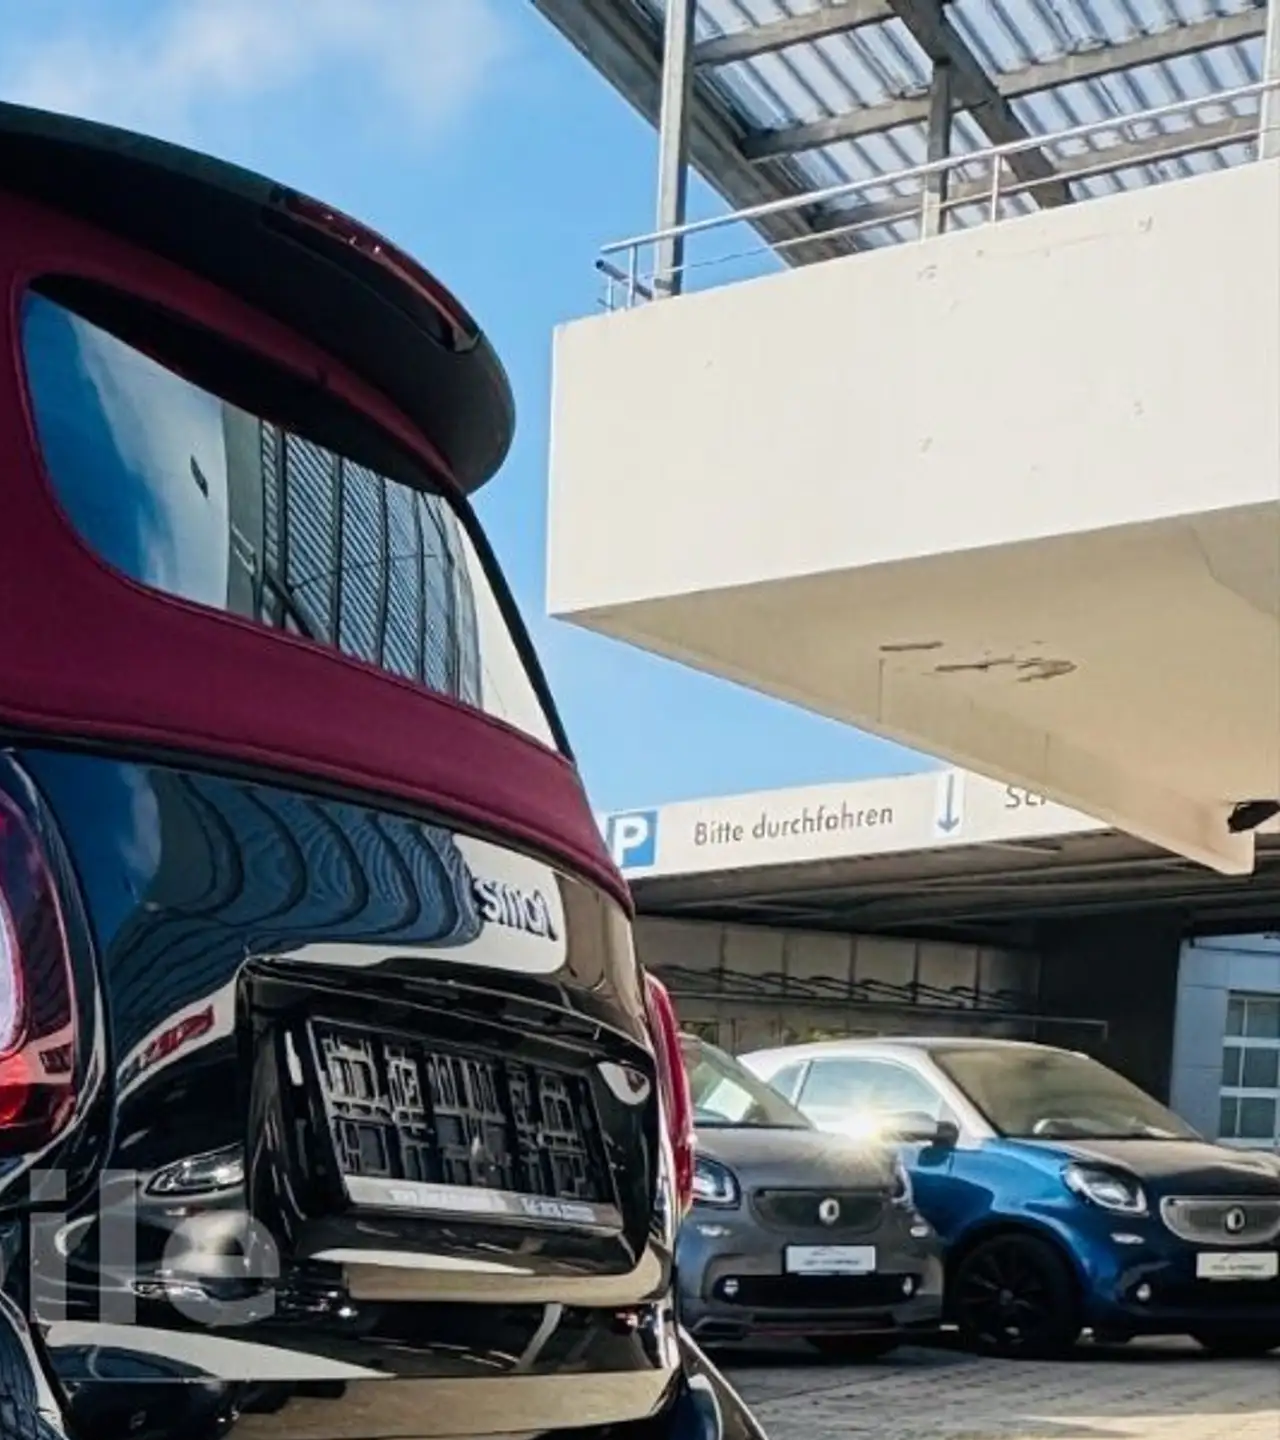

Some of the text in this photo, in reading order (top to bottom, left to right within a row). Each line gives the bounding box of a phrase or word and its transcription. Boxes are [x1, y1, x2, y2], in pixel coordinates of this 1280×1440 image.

[1005, 783, 1046, 808] Sc
[615, 816, 648, 869] P
[694, 801, 894, 846] Bitte durchfahren
